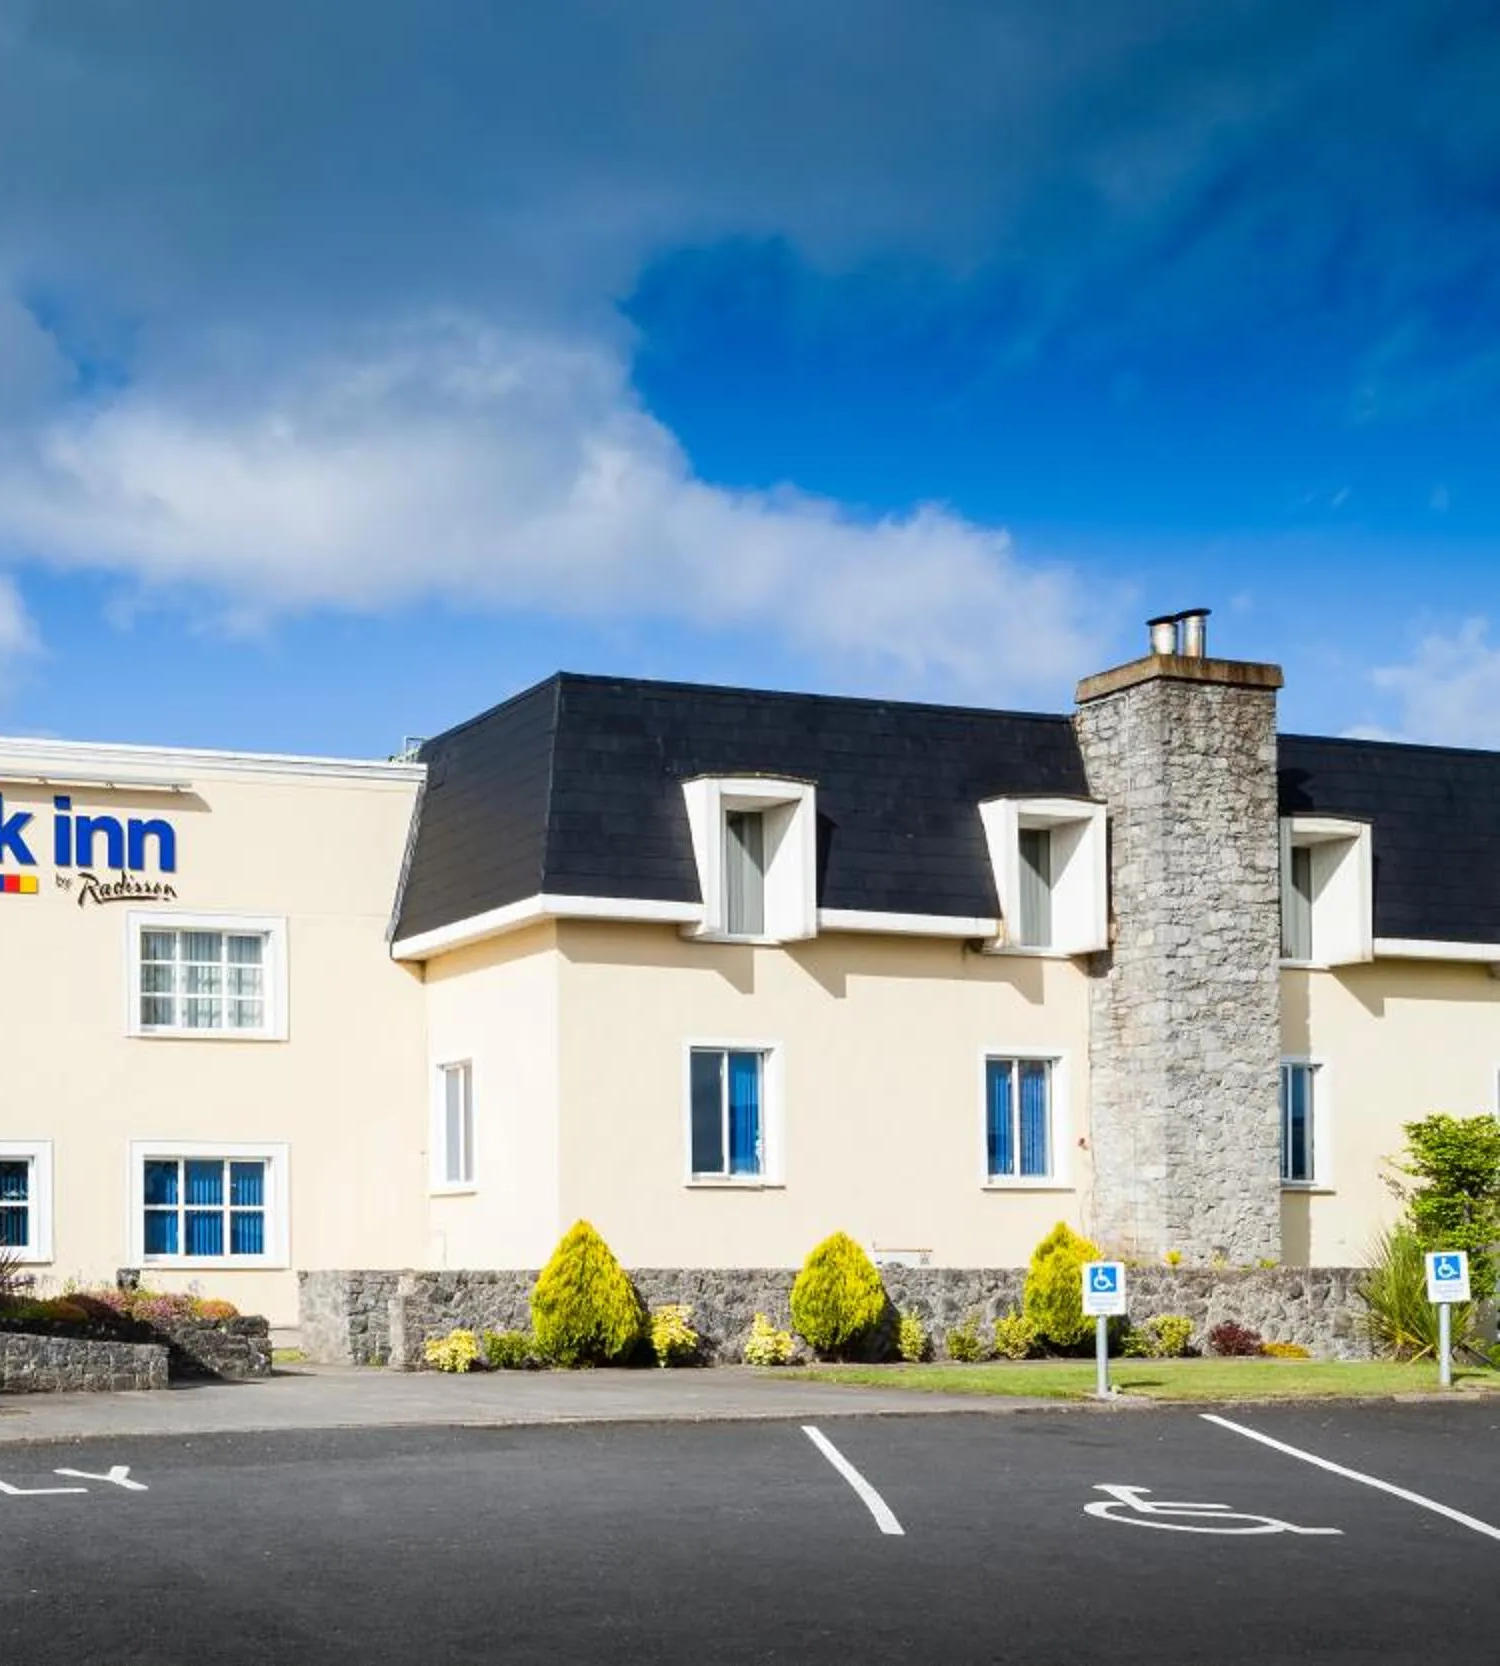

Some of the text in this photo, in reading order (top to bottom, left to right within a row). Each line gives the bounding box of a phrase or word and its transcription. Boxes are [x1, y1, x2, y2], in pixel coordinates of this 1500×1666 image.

[53, 795, 176, 872] inn
[55, 871, 178, 907] by Radisson
